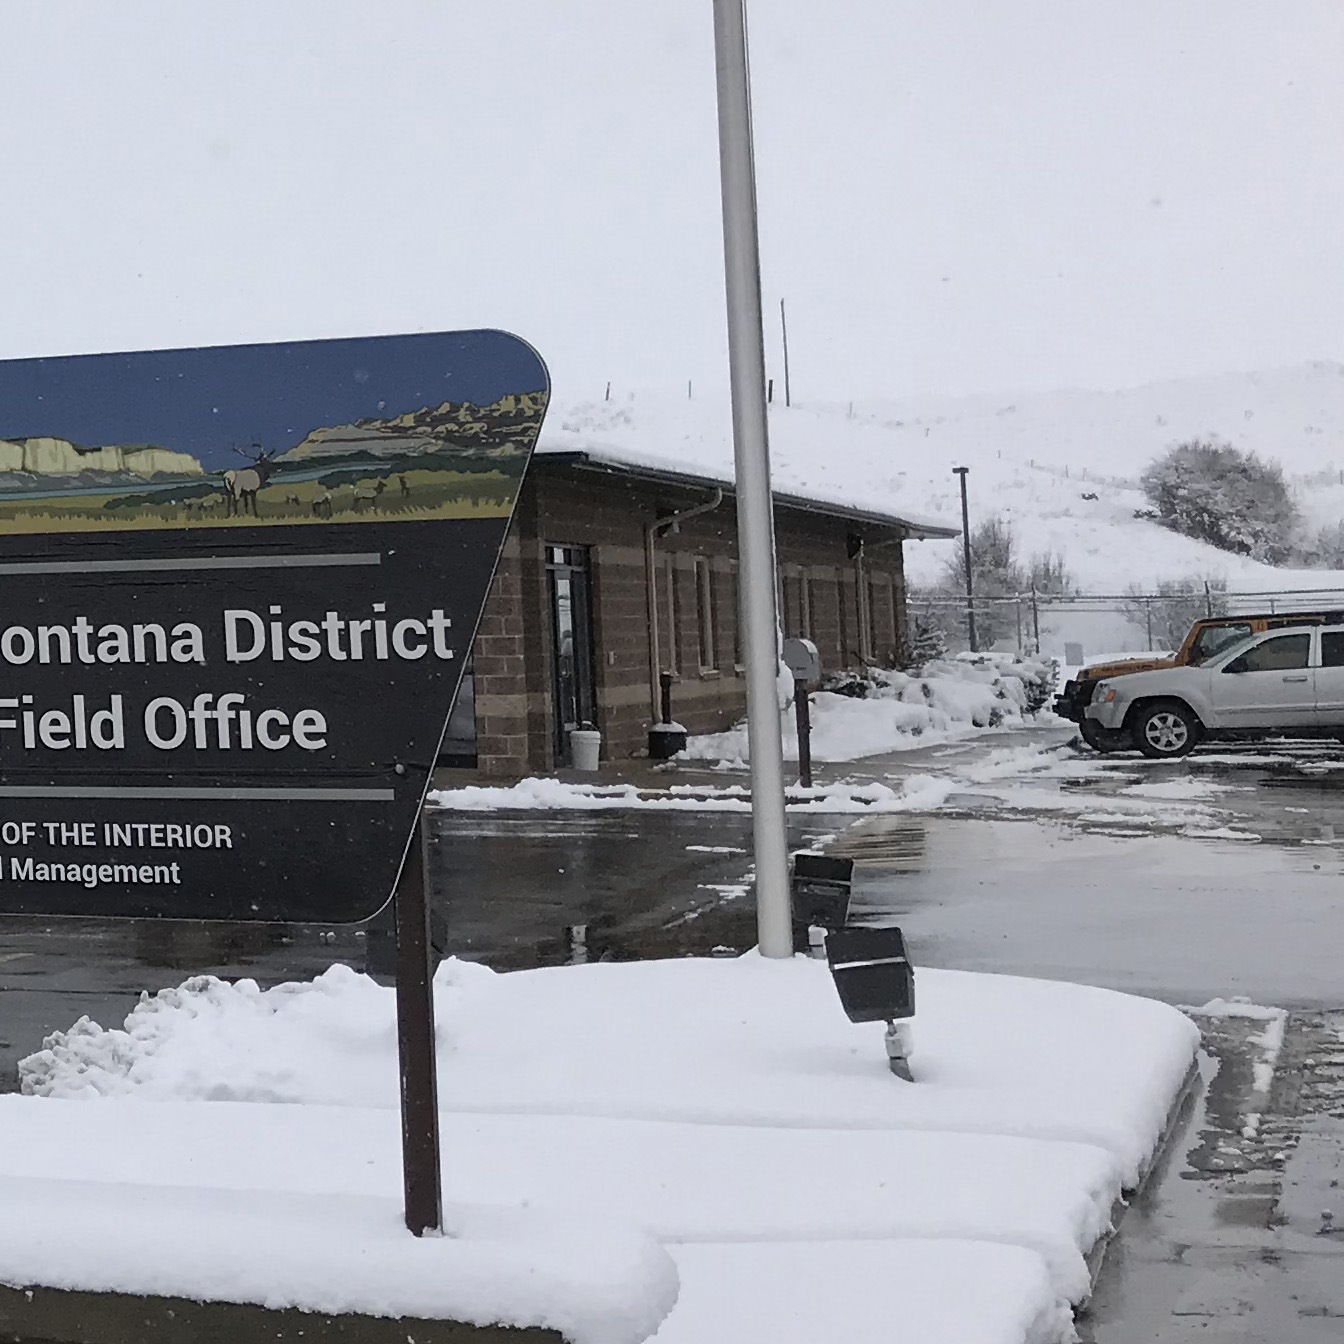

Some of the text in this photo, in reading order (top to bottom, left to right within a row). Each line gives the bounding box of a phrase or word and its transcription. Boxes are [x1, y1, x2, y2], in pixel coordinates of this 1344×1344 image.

[223, 602, 454, 664] District
[144, 692, 327, 750] Office
[1, 821, 37, 845] OF
[42, 822, 97, 846] THE
[104, 823, 233, 849] INTERIOR
[10, 857, 181, 888] Management
